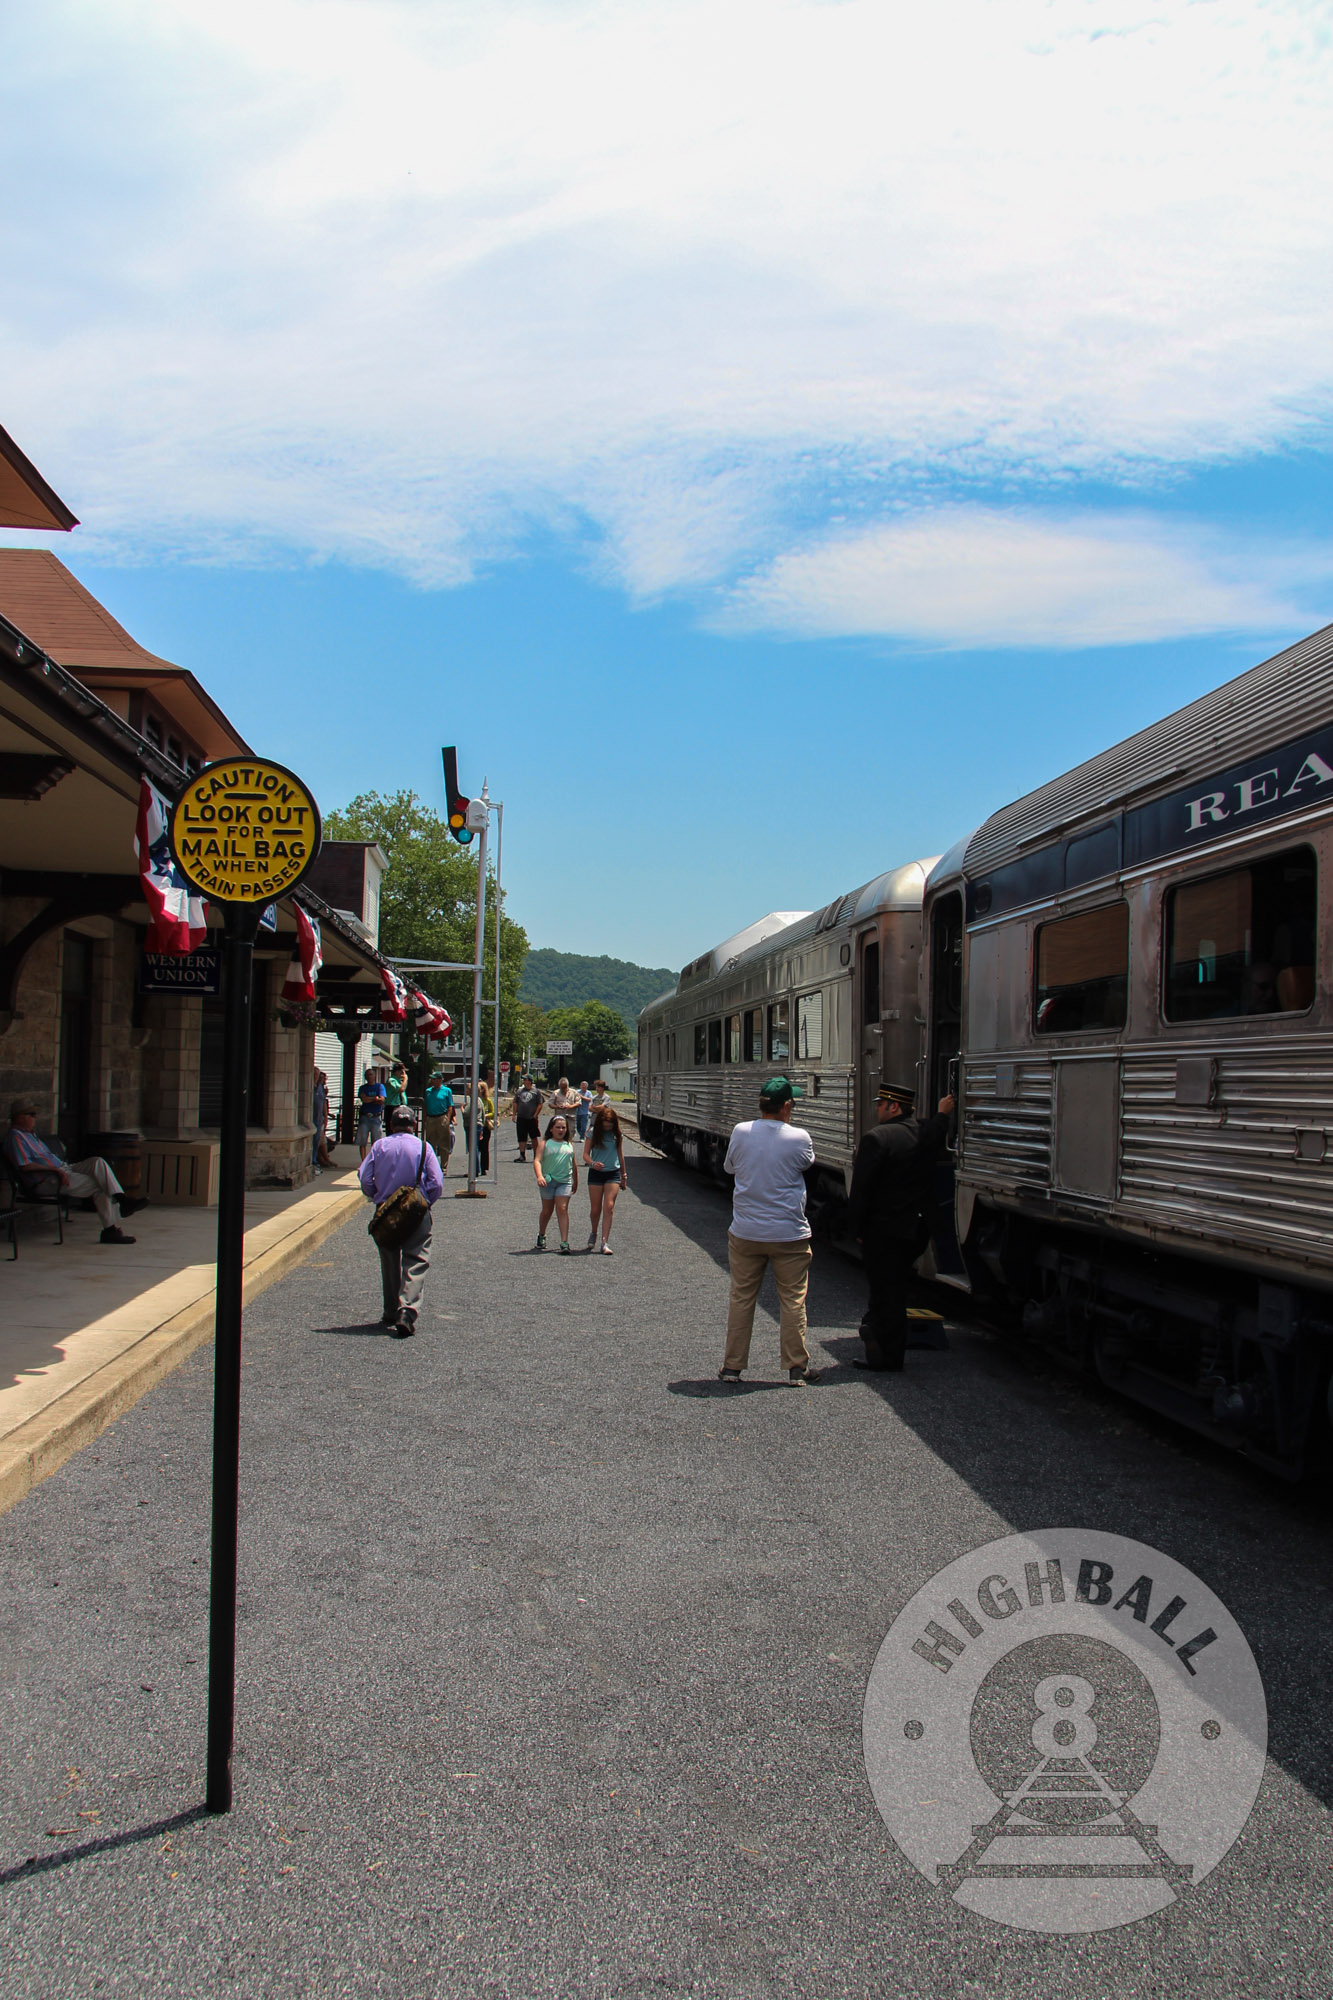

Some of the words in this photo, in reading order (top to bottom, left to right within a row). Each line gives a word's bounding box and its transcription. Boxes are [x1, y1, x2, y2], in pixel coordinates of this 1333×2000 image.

[194, 768, 295, 803] CAUTION
[1184, 752, 1333, 833] REA
[183, 803, 252, 823] LOOK
[258, 806, 309, 825] OUT
[227, 825, 264, 839] FOR
[182, 838, 247, 857] MAIL
[254, 840, 306, 858] BAG
[213, 859, 269, 873] WHEN
[189, 857, 236, 895] TRAIN
[240, 858, 301, 897] PASSES
[145, 953, 217, 968] WESTERN
[153, 968, 208, 983] UNION
[361, 1020, 401, 1031] OFFICE
